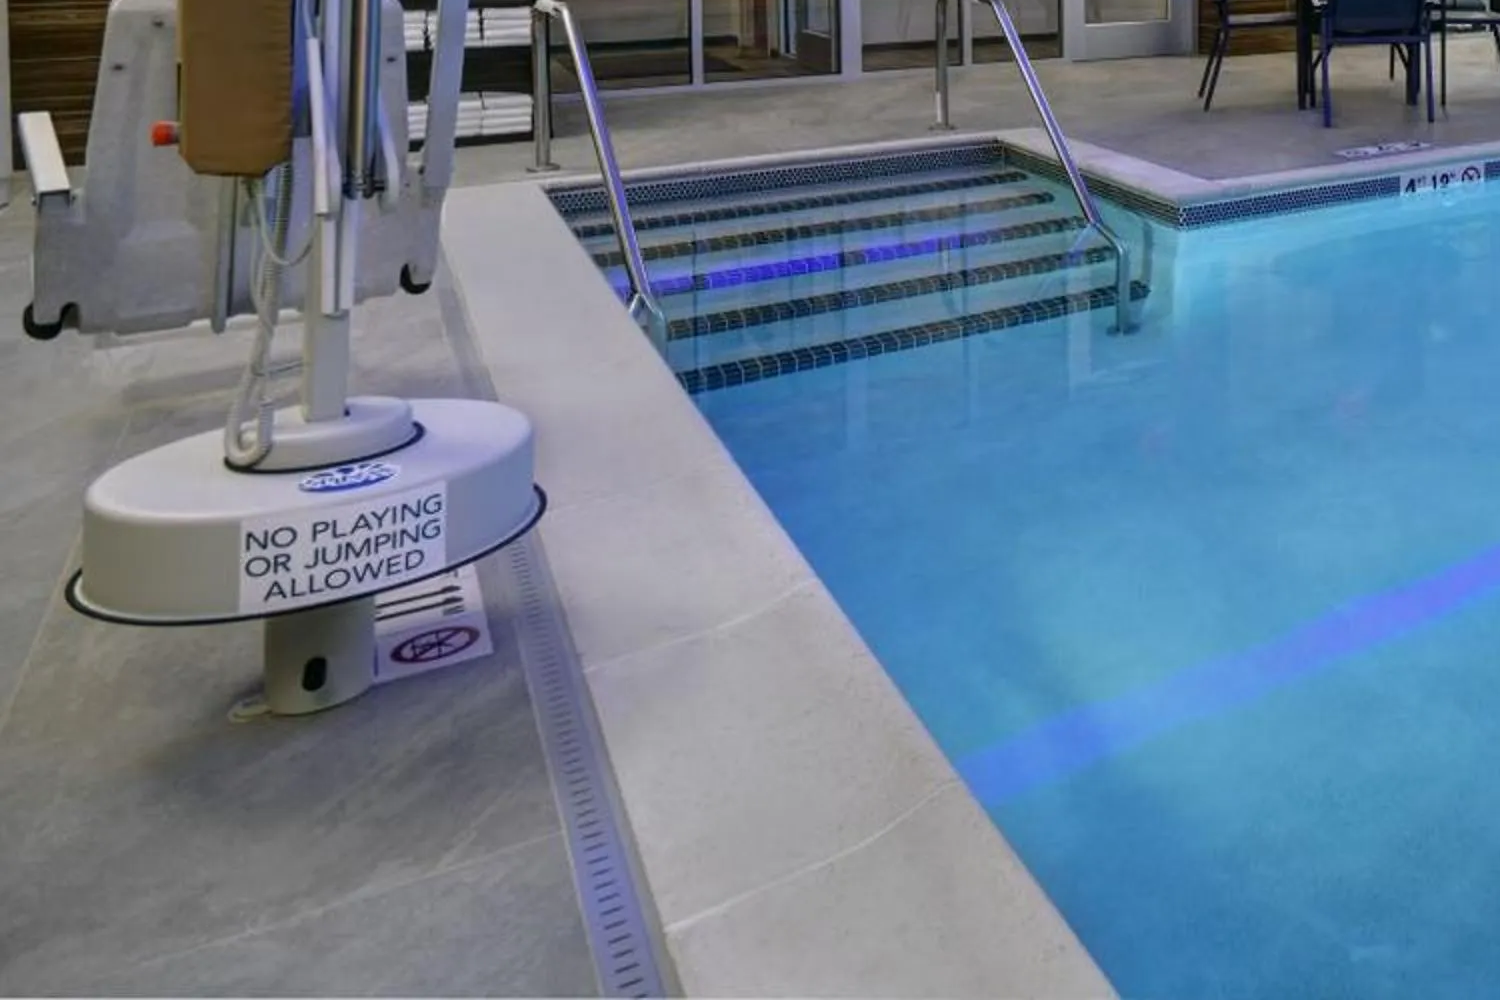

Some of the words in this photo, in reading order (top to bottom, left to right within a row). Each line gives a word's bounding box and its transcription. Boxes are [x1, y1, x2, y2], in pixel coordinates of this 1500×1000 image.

[244, 526, 298, 552] NO
[310, 493, 443, 543] PLAYING
[244, 552, 292, 578] OR
[304, 517, 442, 569] JUMPING
[262, 548, 425, 602] ALLOWED
